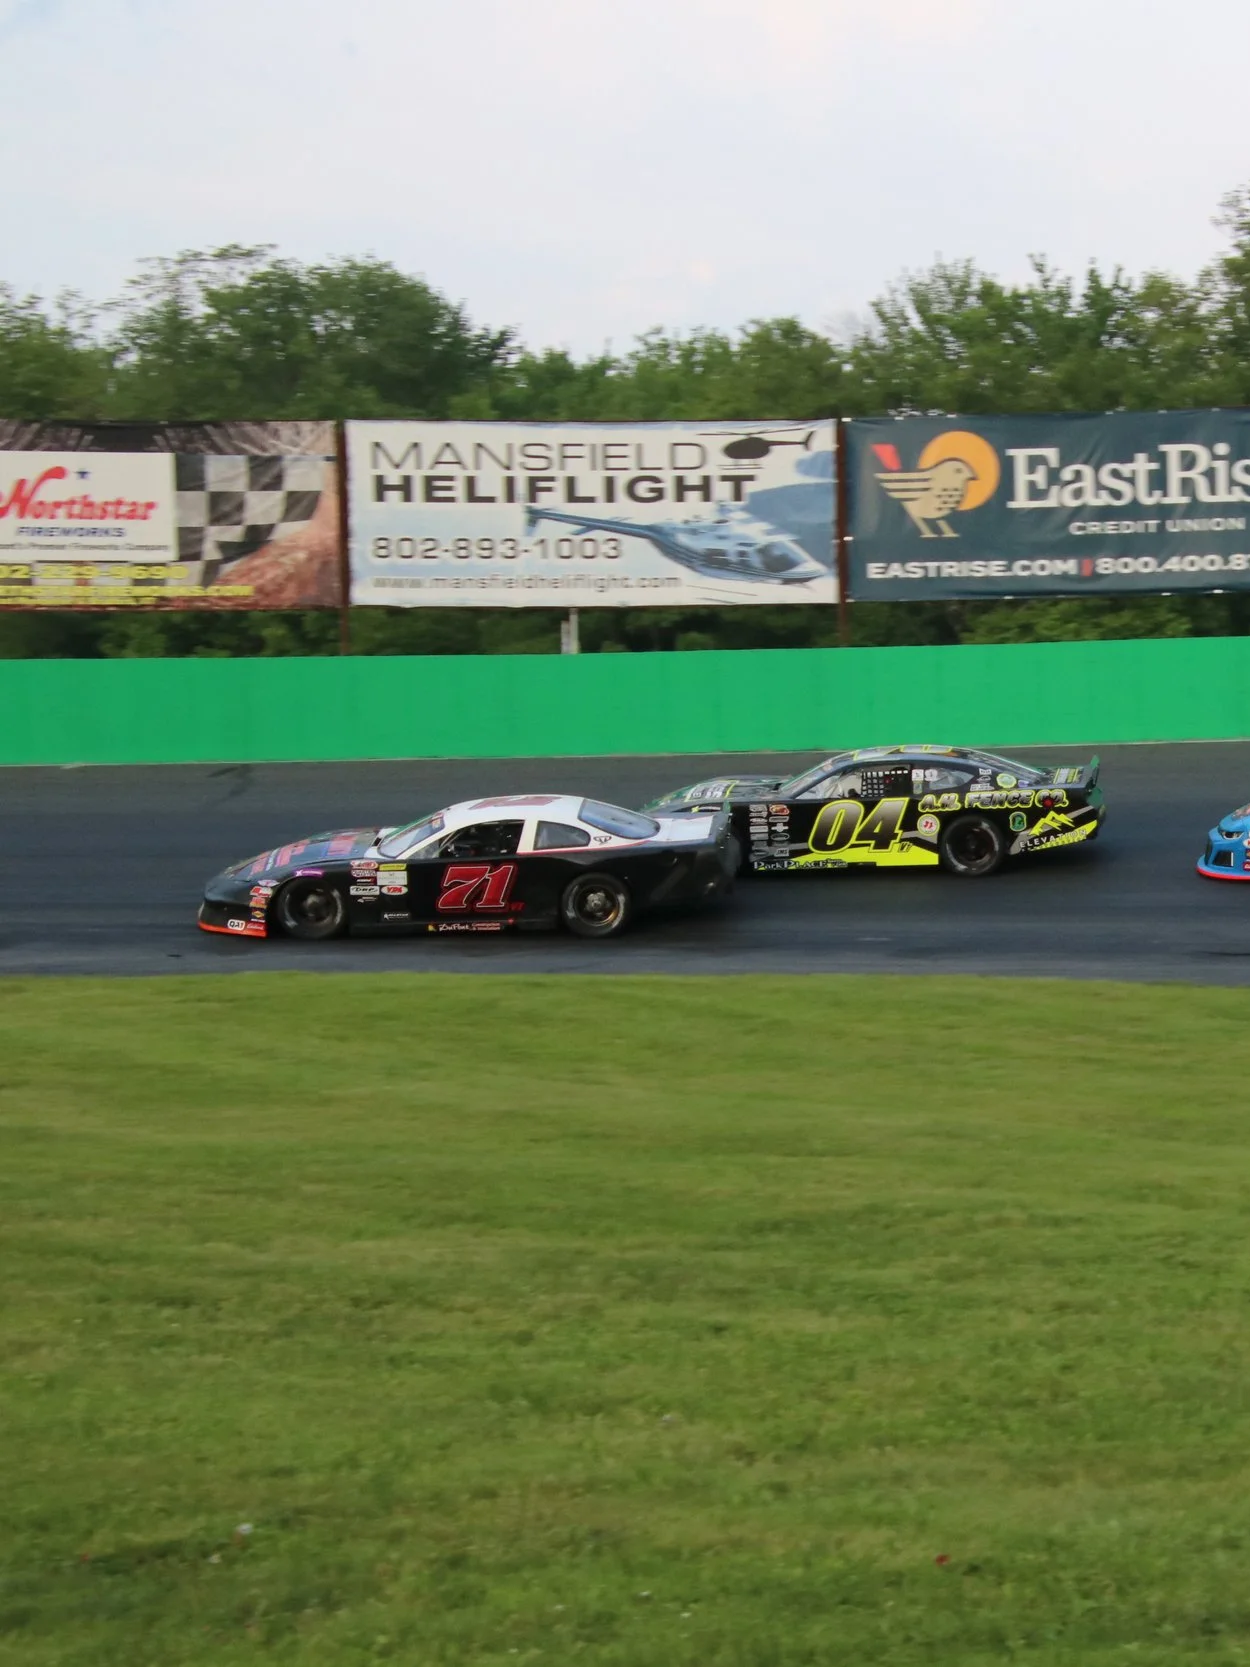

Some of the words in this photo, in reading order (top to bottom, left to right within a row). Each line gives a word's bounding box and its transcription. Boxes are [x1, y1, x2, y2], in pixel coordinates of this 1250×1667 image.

[370, 441, 707, 471] MANSFIELD
[0, 466, 157, 520] Northstar
[374, 474, 757, 503] HELIFLIGHT
[17, 526, 126, 538] FIREWORKS
[1068, 519, 1160, 536] CREDIT
[1166, 517, 1245, 533] UNION
[372, 537, 622, 559] 802-893-1003
[866, 560, 1078, 579] EASTRISE.COM
[372, 573, 682, 592] www.mansfieldheliflight.com
[964, 790, 1037, 809] FENCE
[808, 798, 910, 854] 04
[1020, 829, 1088, 849] ELEVATION
[438, 864, 514, 909] 71
[229, 920, 245, 930] QA1
